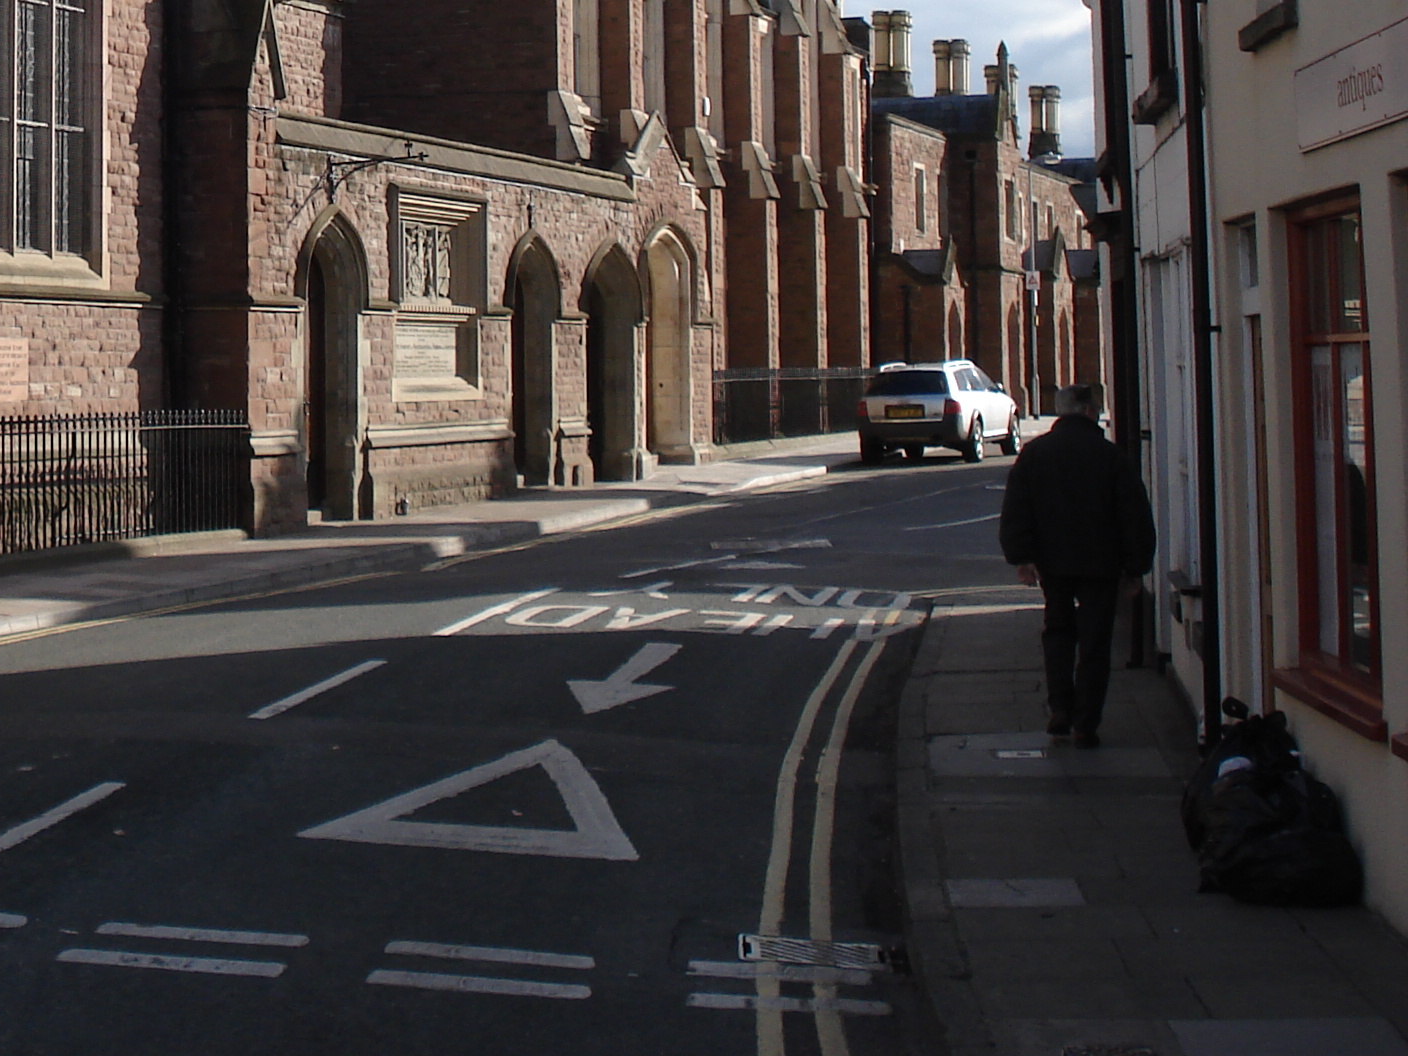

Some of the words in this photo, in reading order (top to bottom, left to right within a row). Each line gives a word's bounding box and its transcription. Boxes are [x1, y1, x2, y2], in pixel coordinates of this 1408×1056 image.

[1337, 64, 1383, 112] antiques
[588, 581, 912, 610] ONLY
[505, 604, 920, 641] AHEAD
